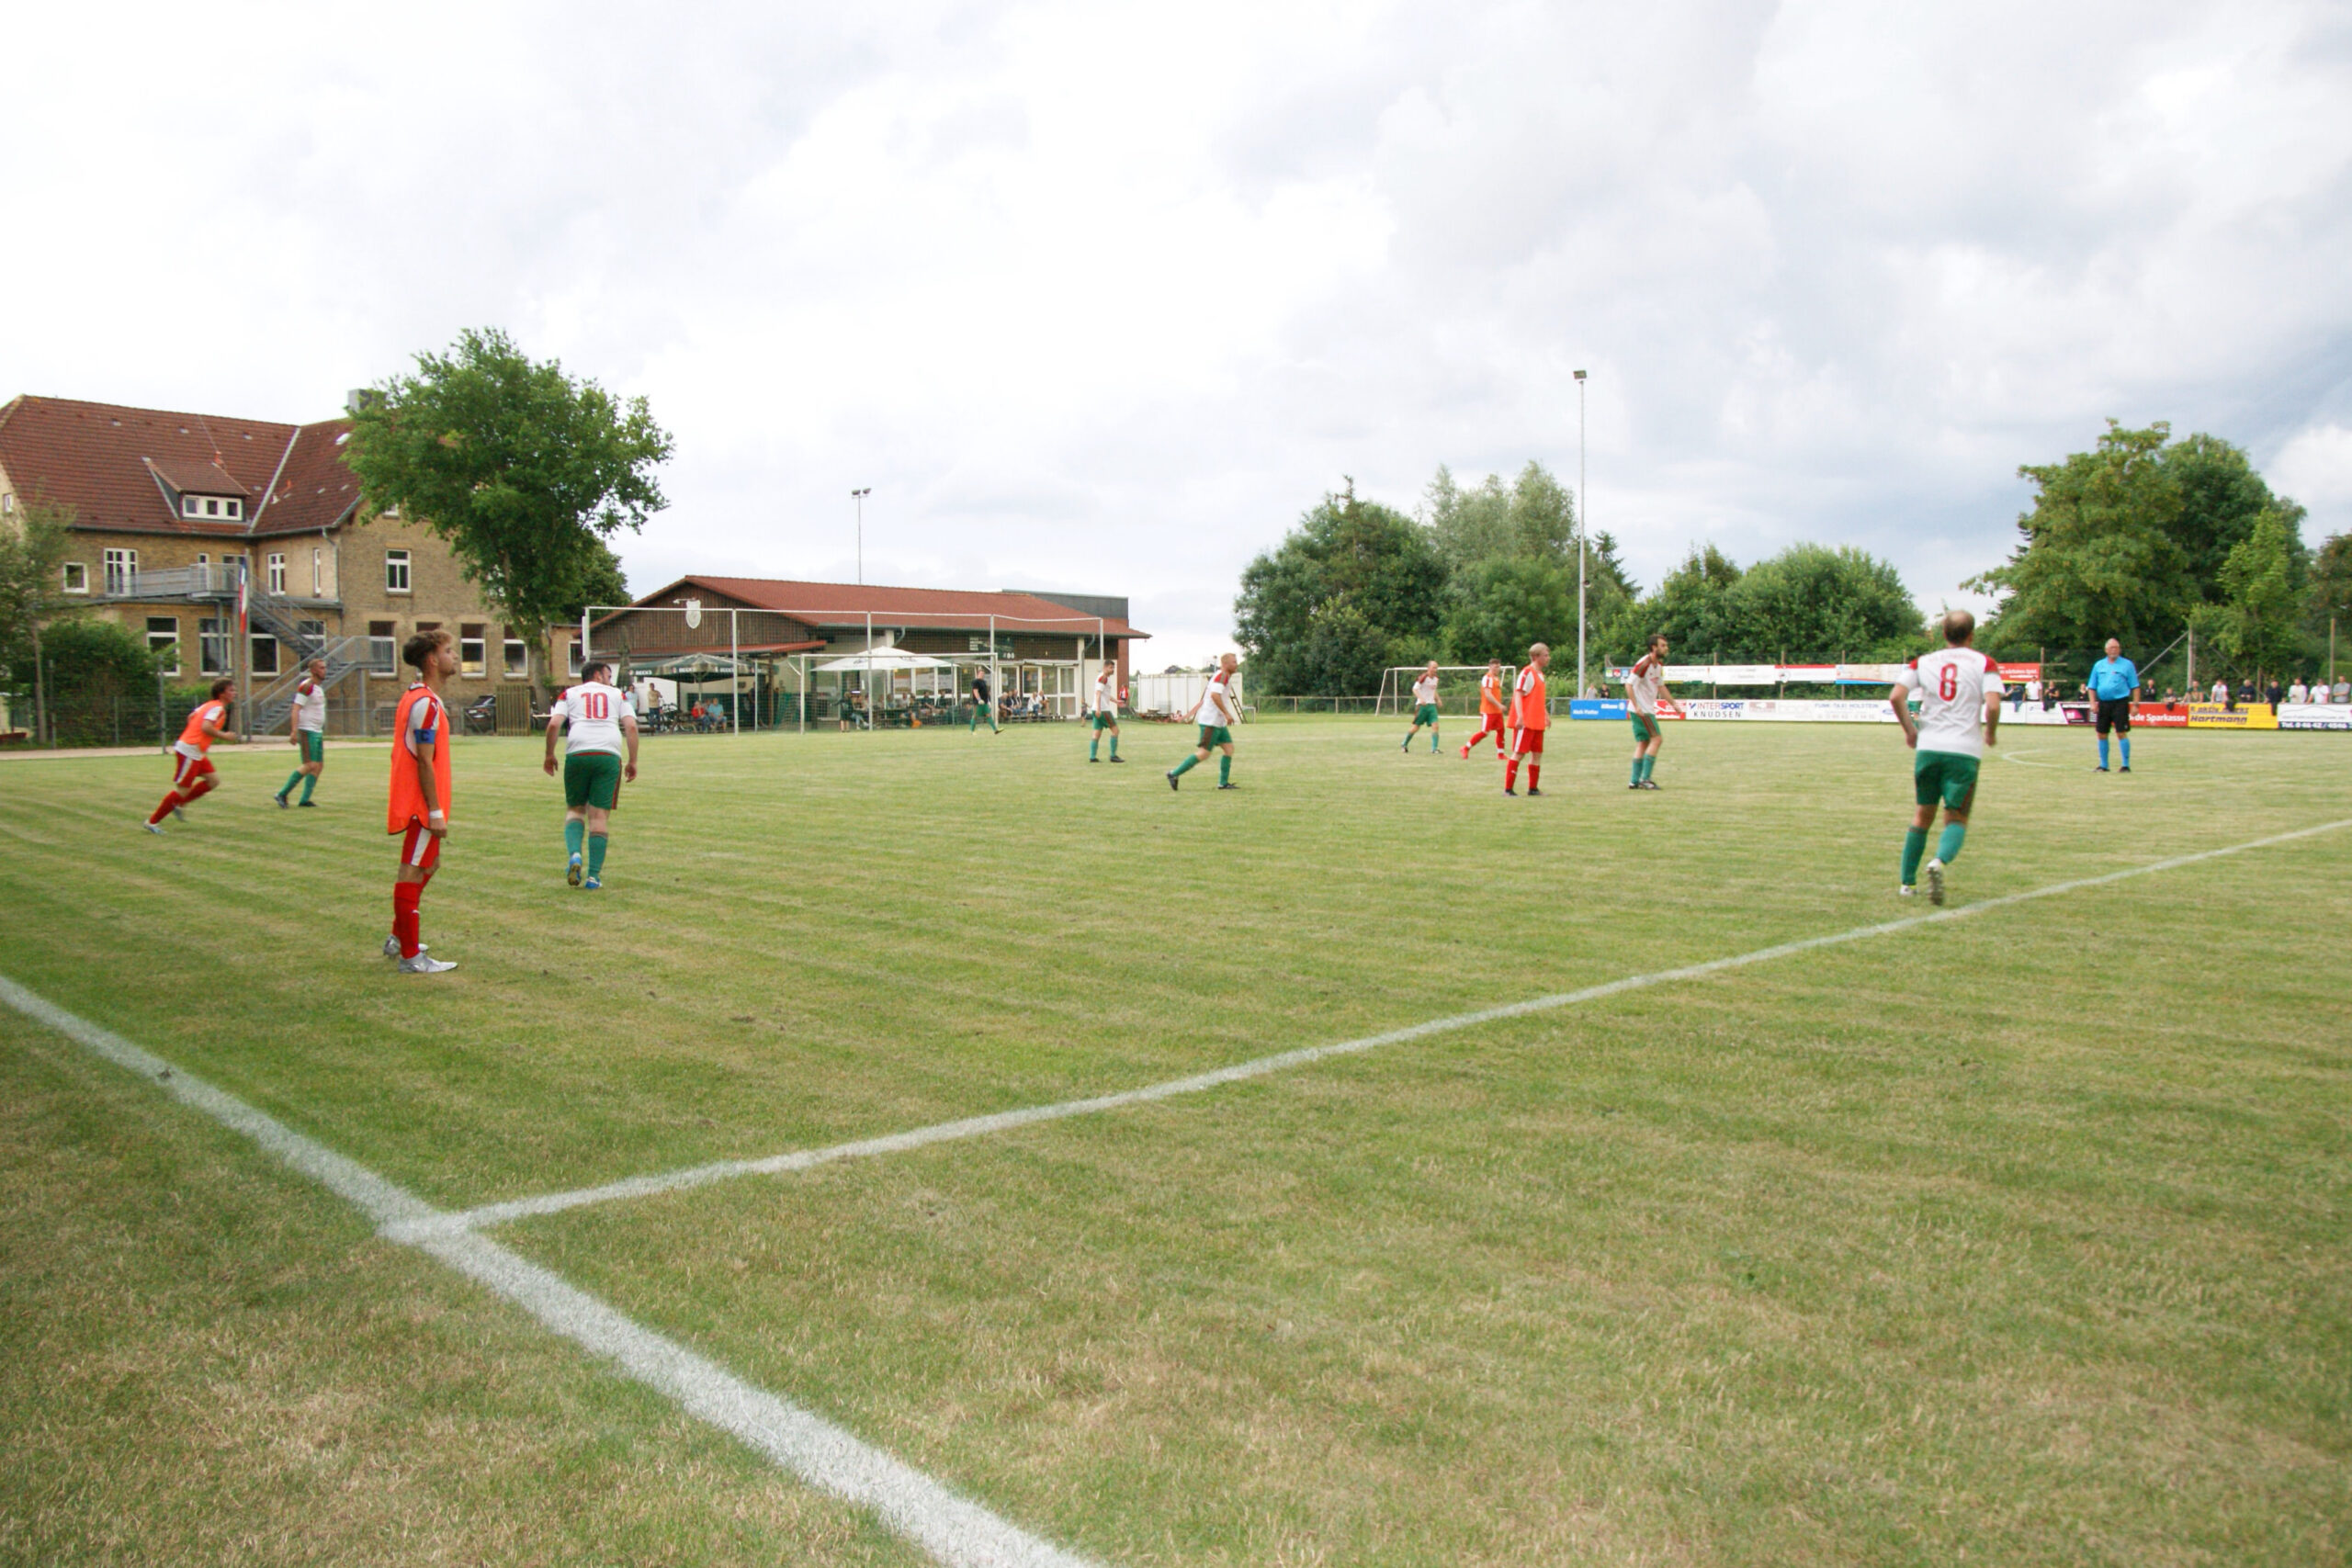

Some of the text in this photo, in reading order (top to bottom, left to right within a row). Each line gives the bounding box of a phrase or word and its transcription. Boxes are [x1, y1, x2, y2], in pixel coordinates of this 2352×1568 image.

[1939, 663, 1958, 702] 8
[581, 692, 609, 720] 10
[1697, 702, 1744, 710] INTERSPORT
[2146, 713, 2187, 723] Sparkasse
[420, 730, 430, 742] C
